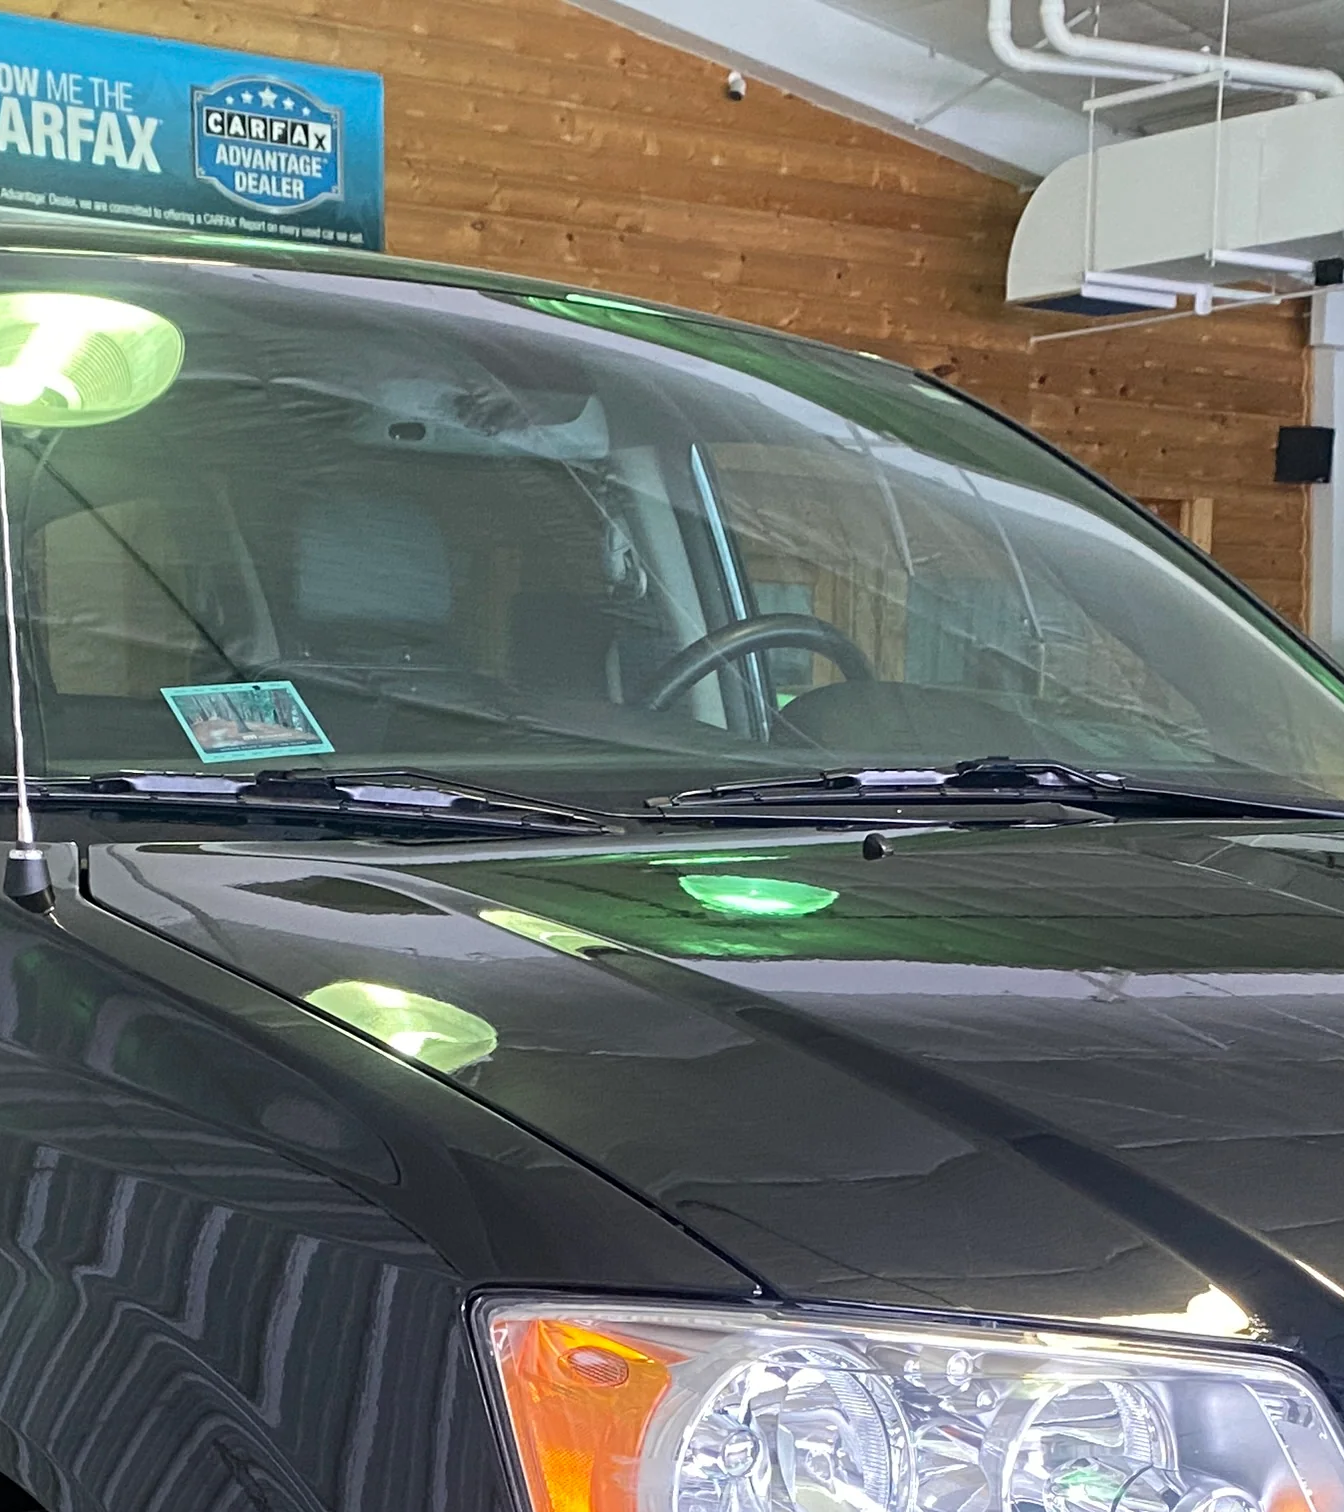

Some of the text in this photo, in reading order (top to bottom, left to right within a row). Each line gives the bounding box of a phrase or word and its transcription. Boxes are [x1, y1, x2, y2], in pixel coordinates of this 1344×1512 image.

[46, 70, 84, 105] ME
[89, 76, 134, 112] THE
[207, 112, 327, 151] CARFAX
[215, 143, 323, 178] ADVANTAGE
[234, 171, 305, 200] DEALER
